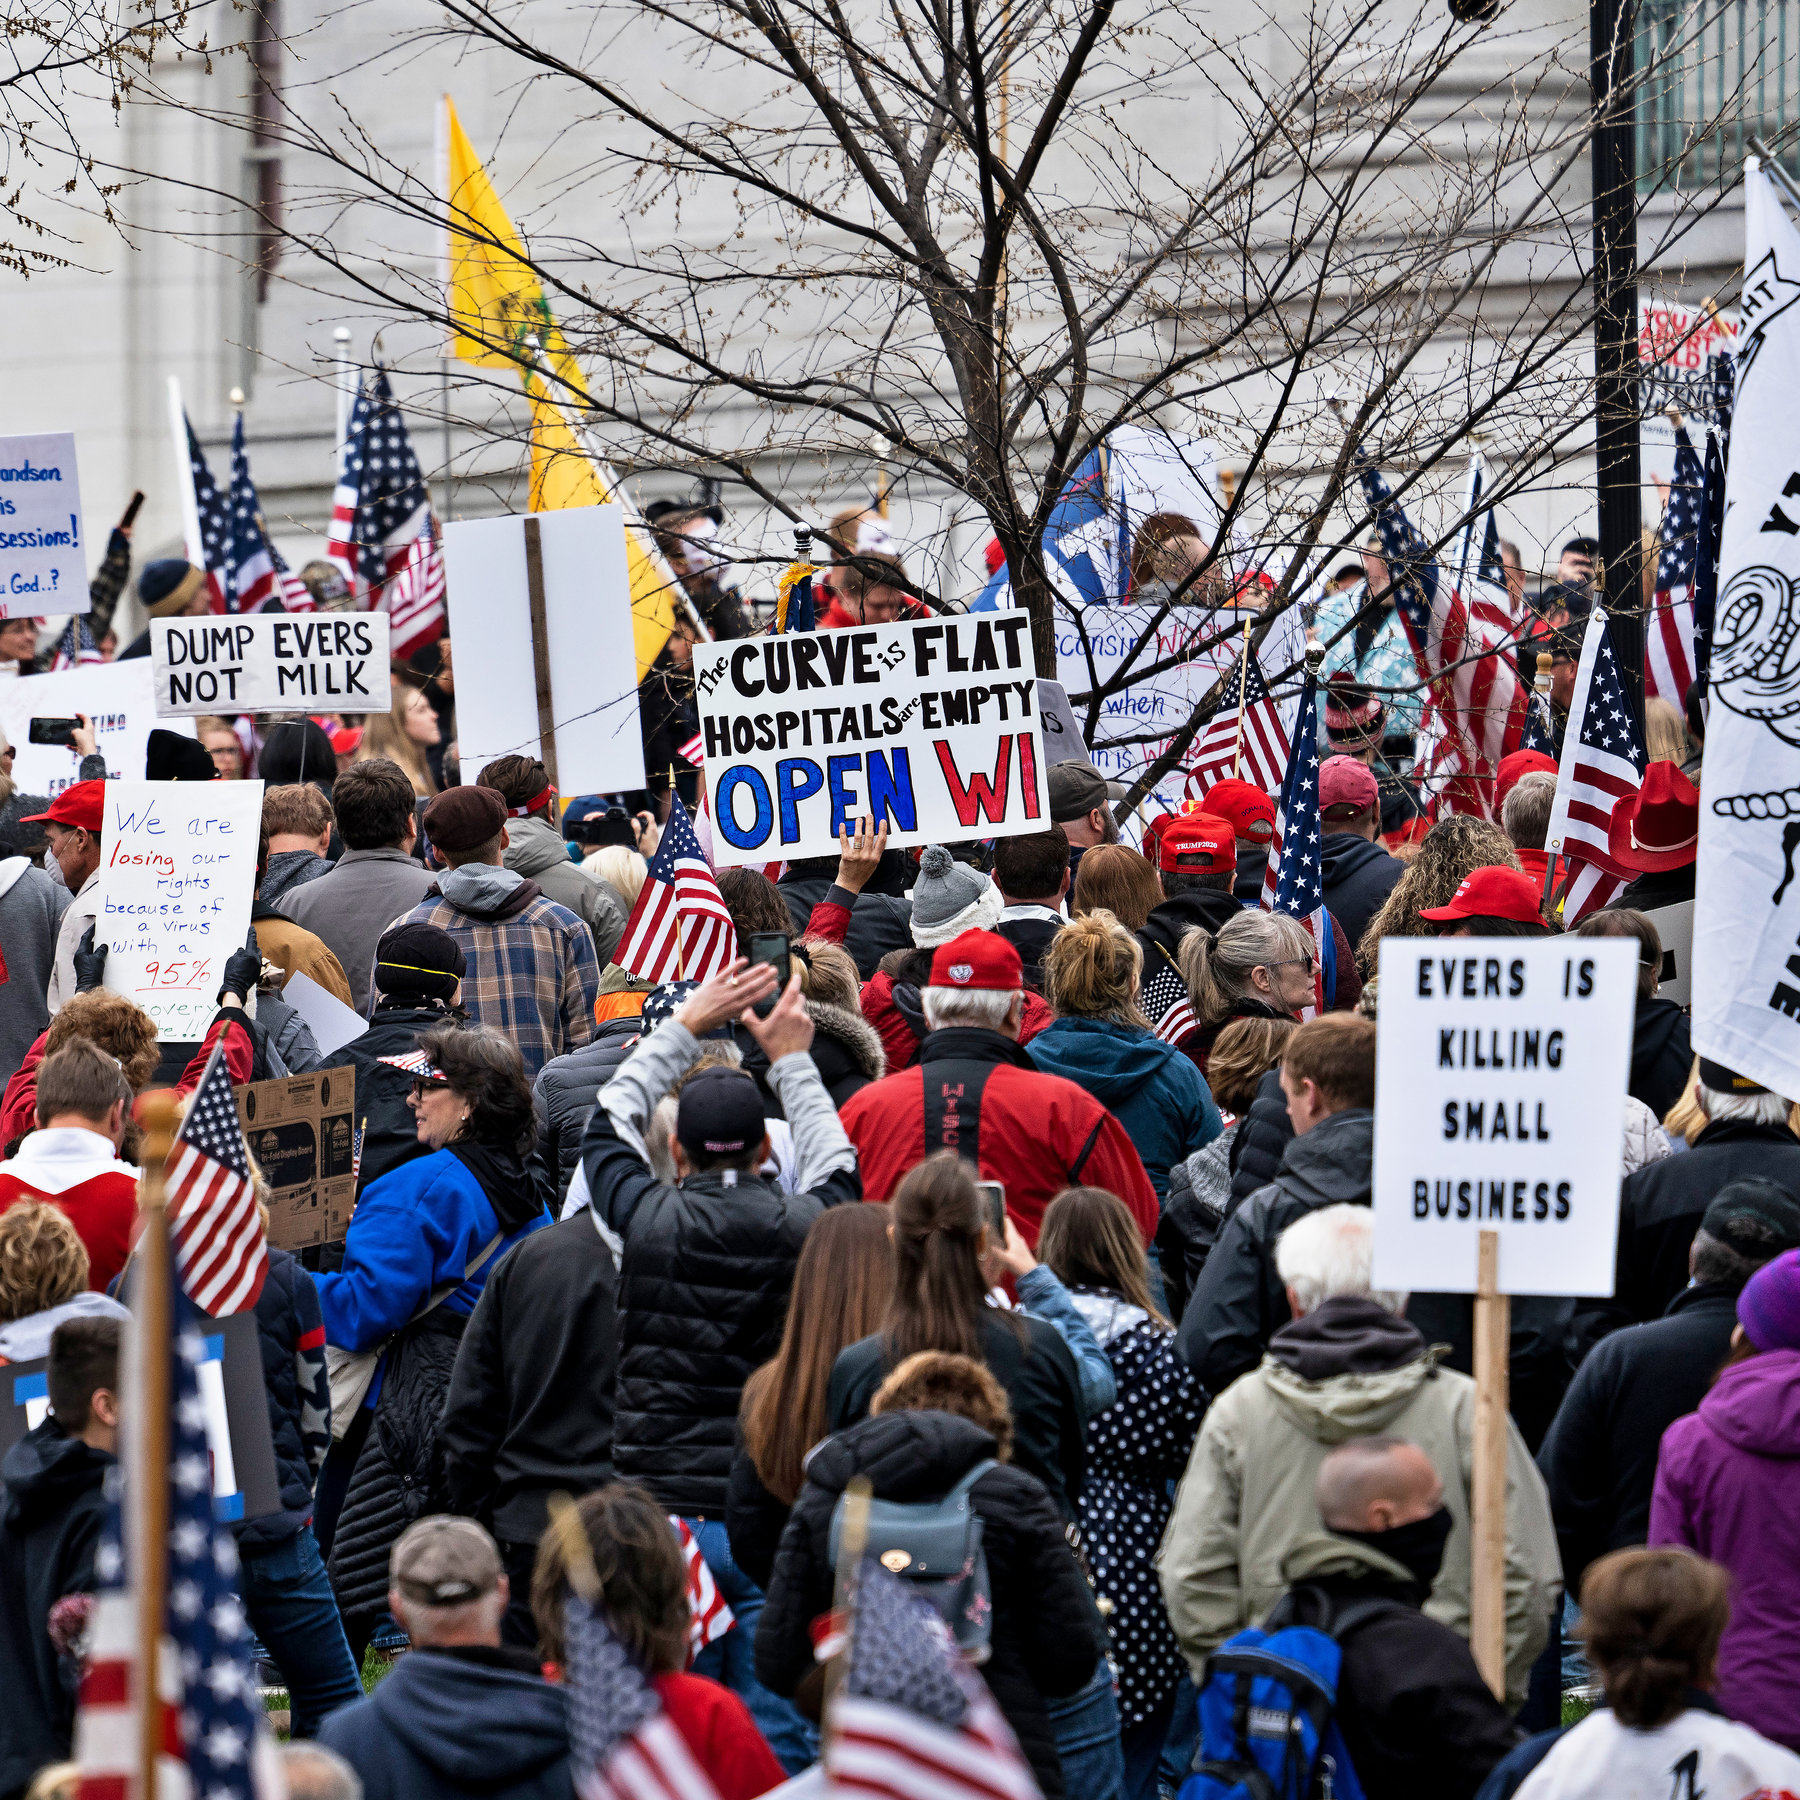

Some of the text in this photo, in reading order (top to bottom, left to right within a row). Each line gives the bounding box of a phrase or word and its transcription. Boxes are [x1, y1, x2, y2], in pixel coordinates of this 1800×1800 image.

[1643, 307, 1688, 330] YOU
[167, 621, 373, 666] DUMP EVERS
[697, 616, 1028, 698] The CURVE is FLAT
[1154, 624, 1242, 659] WORK
[169, 660, 370, 705] NOT MILK
[704, 679, 1036, 758] HOSPITALS are EMPTY
[1105, 688, 1166, 717] when
[715, 732, 1042, 850] OPEN WI
[116, 799, 234, 836] We are
[109, 839, 231, 875] losing our
[1175, 841, 1218, 850] TRUMP2020
[157, 872, 210, 898] rights
[104, 894, 225, 916] because of
[137, 920, 211, 935] a virus
[112, 938, 192, 954] with a
[145, 957, 212, 987] 95%
[1418, 958, 1595, 998] EVERS IS
[1438, 1029, 1564, 1069] KILLING
[1444, 1101, 1550, 1141] SMALL
[1413, 1180, 1571, 1221] BUSINESS
